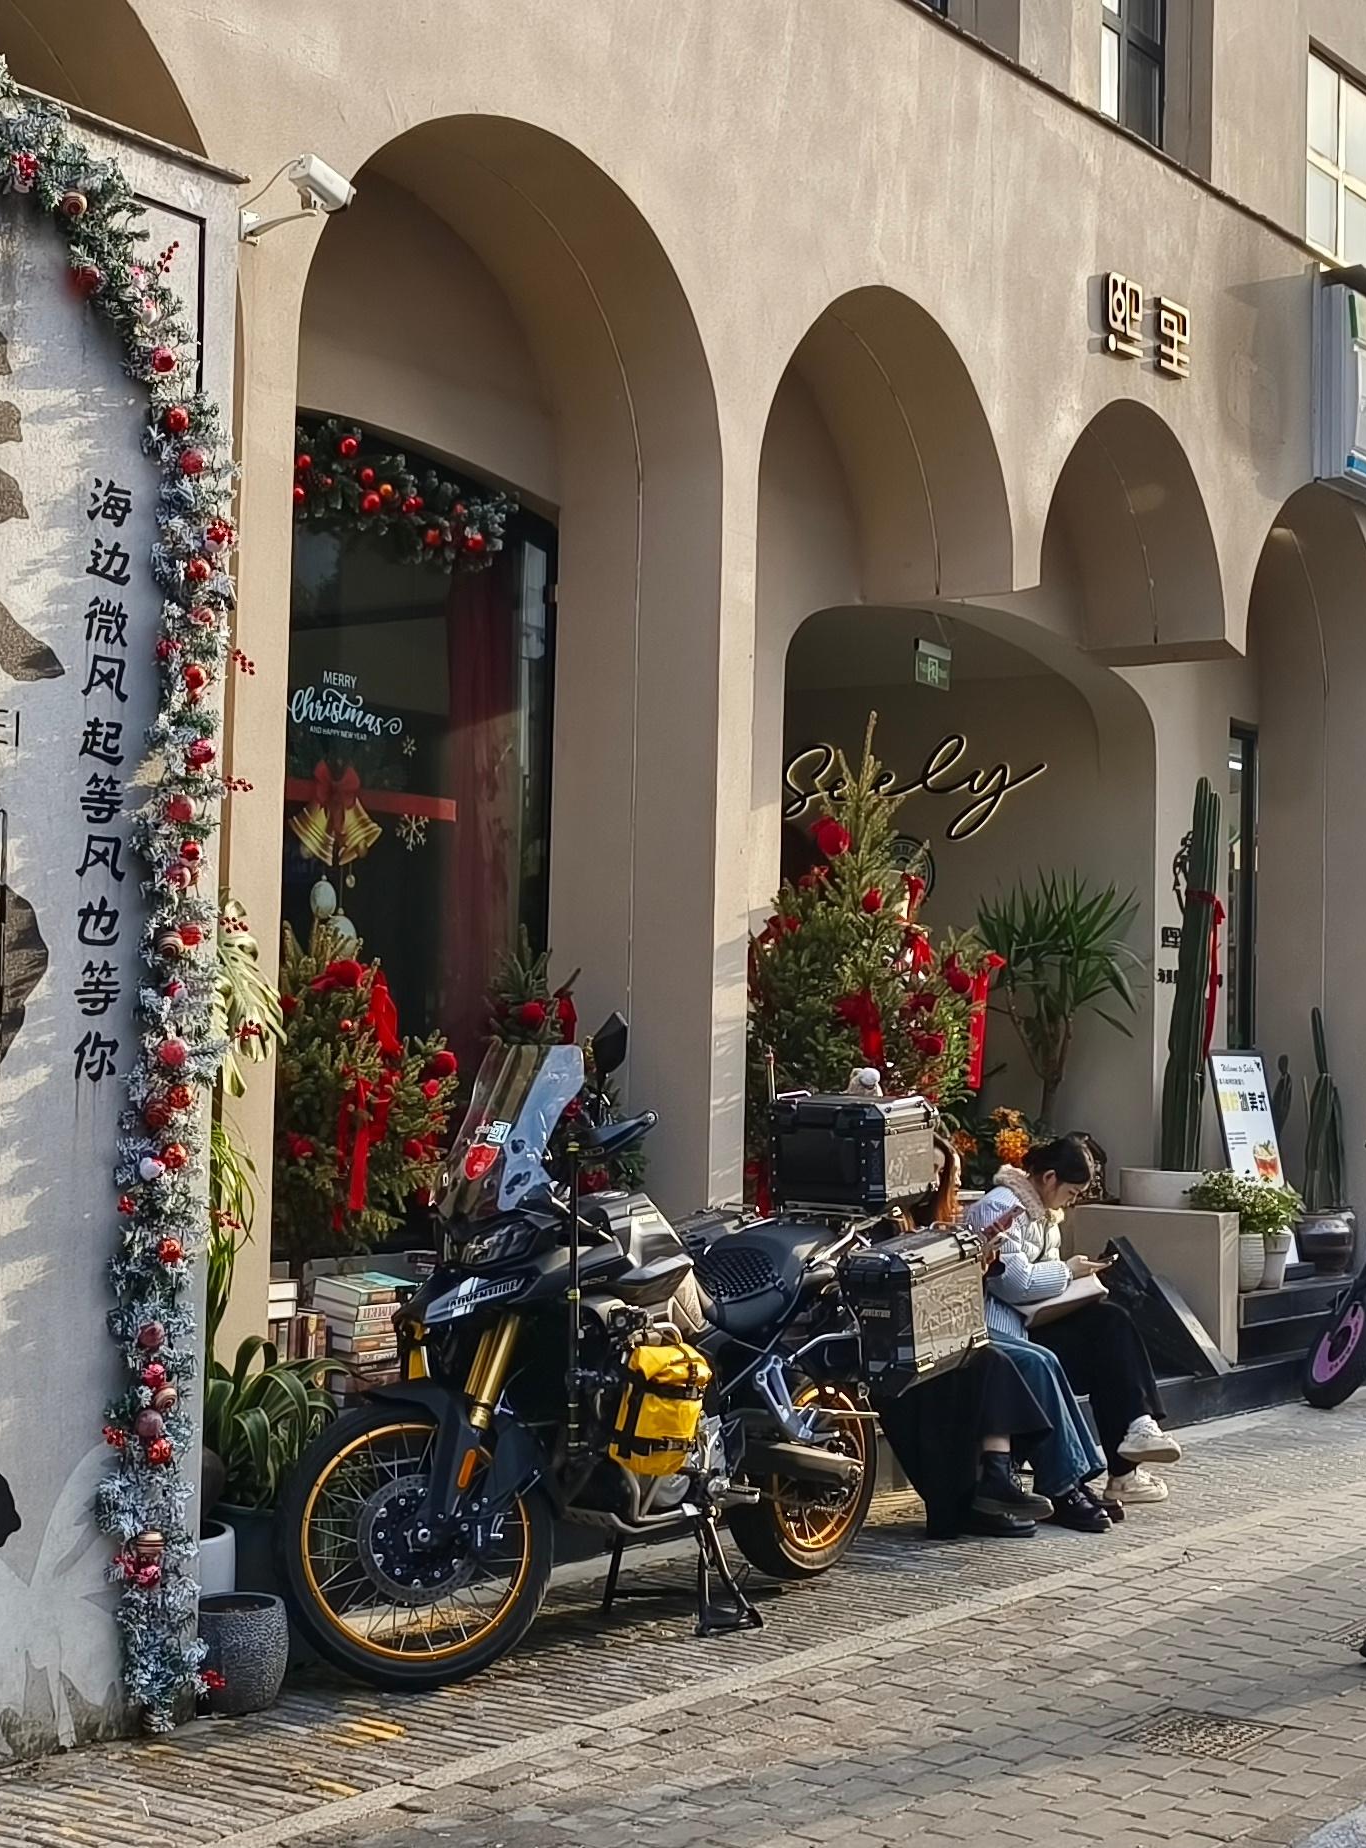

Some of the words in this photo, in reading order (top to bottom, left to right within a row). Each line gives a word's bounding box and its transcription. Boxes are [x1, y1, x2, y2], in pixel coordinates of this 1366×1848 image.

[323, 670, 357, 689] MERRY
[288, 686, 403, 736] Christmas
[73, 478, 133, 1082] 海边微风起等风也等你
